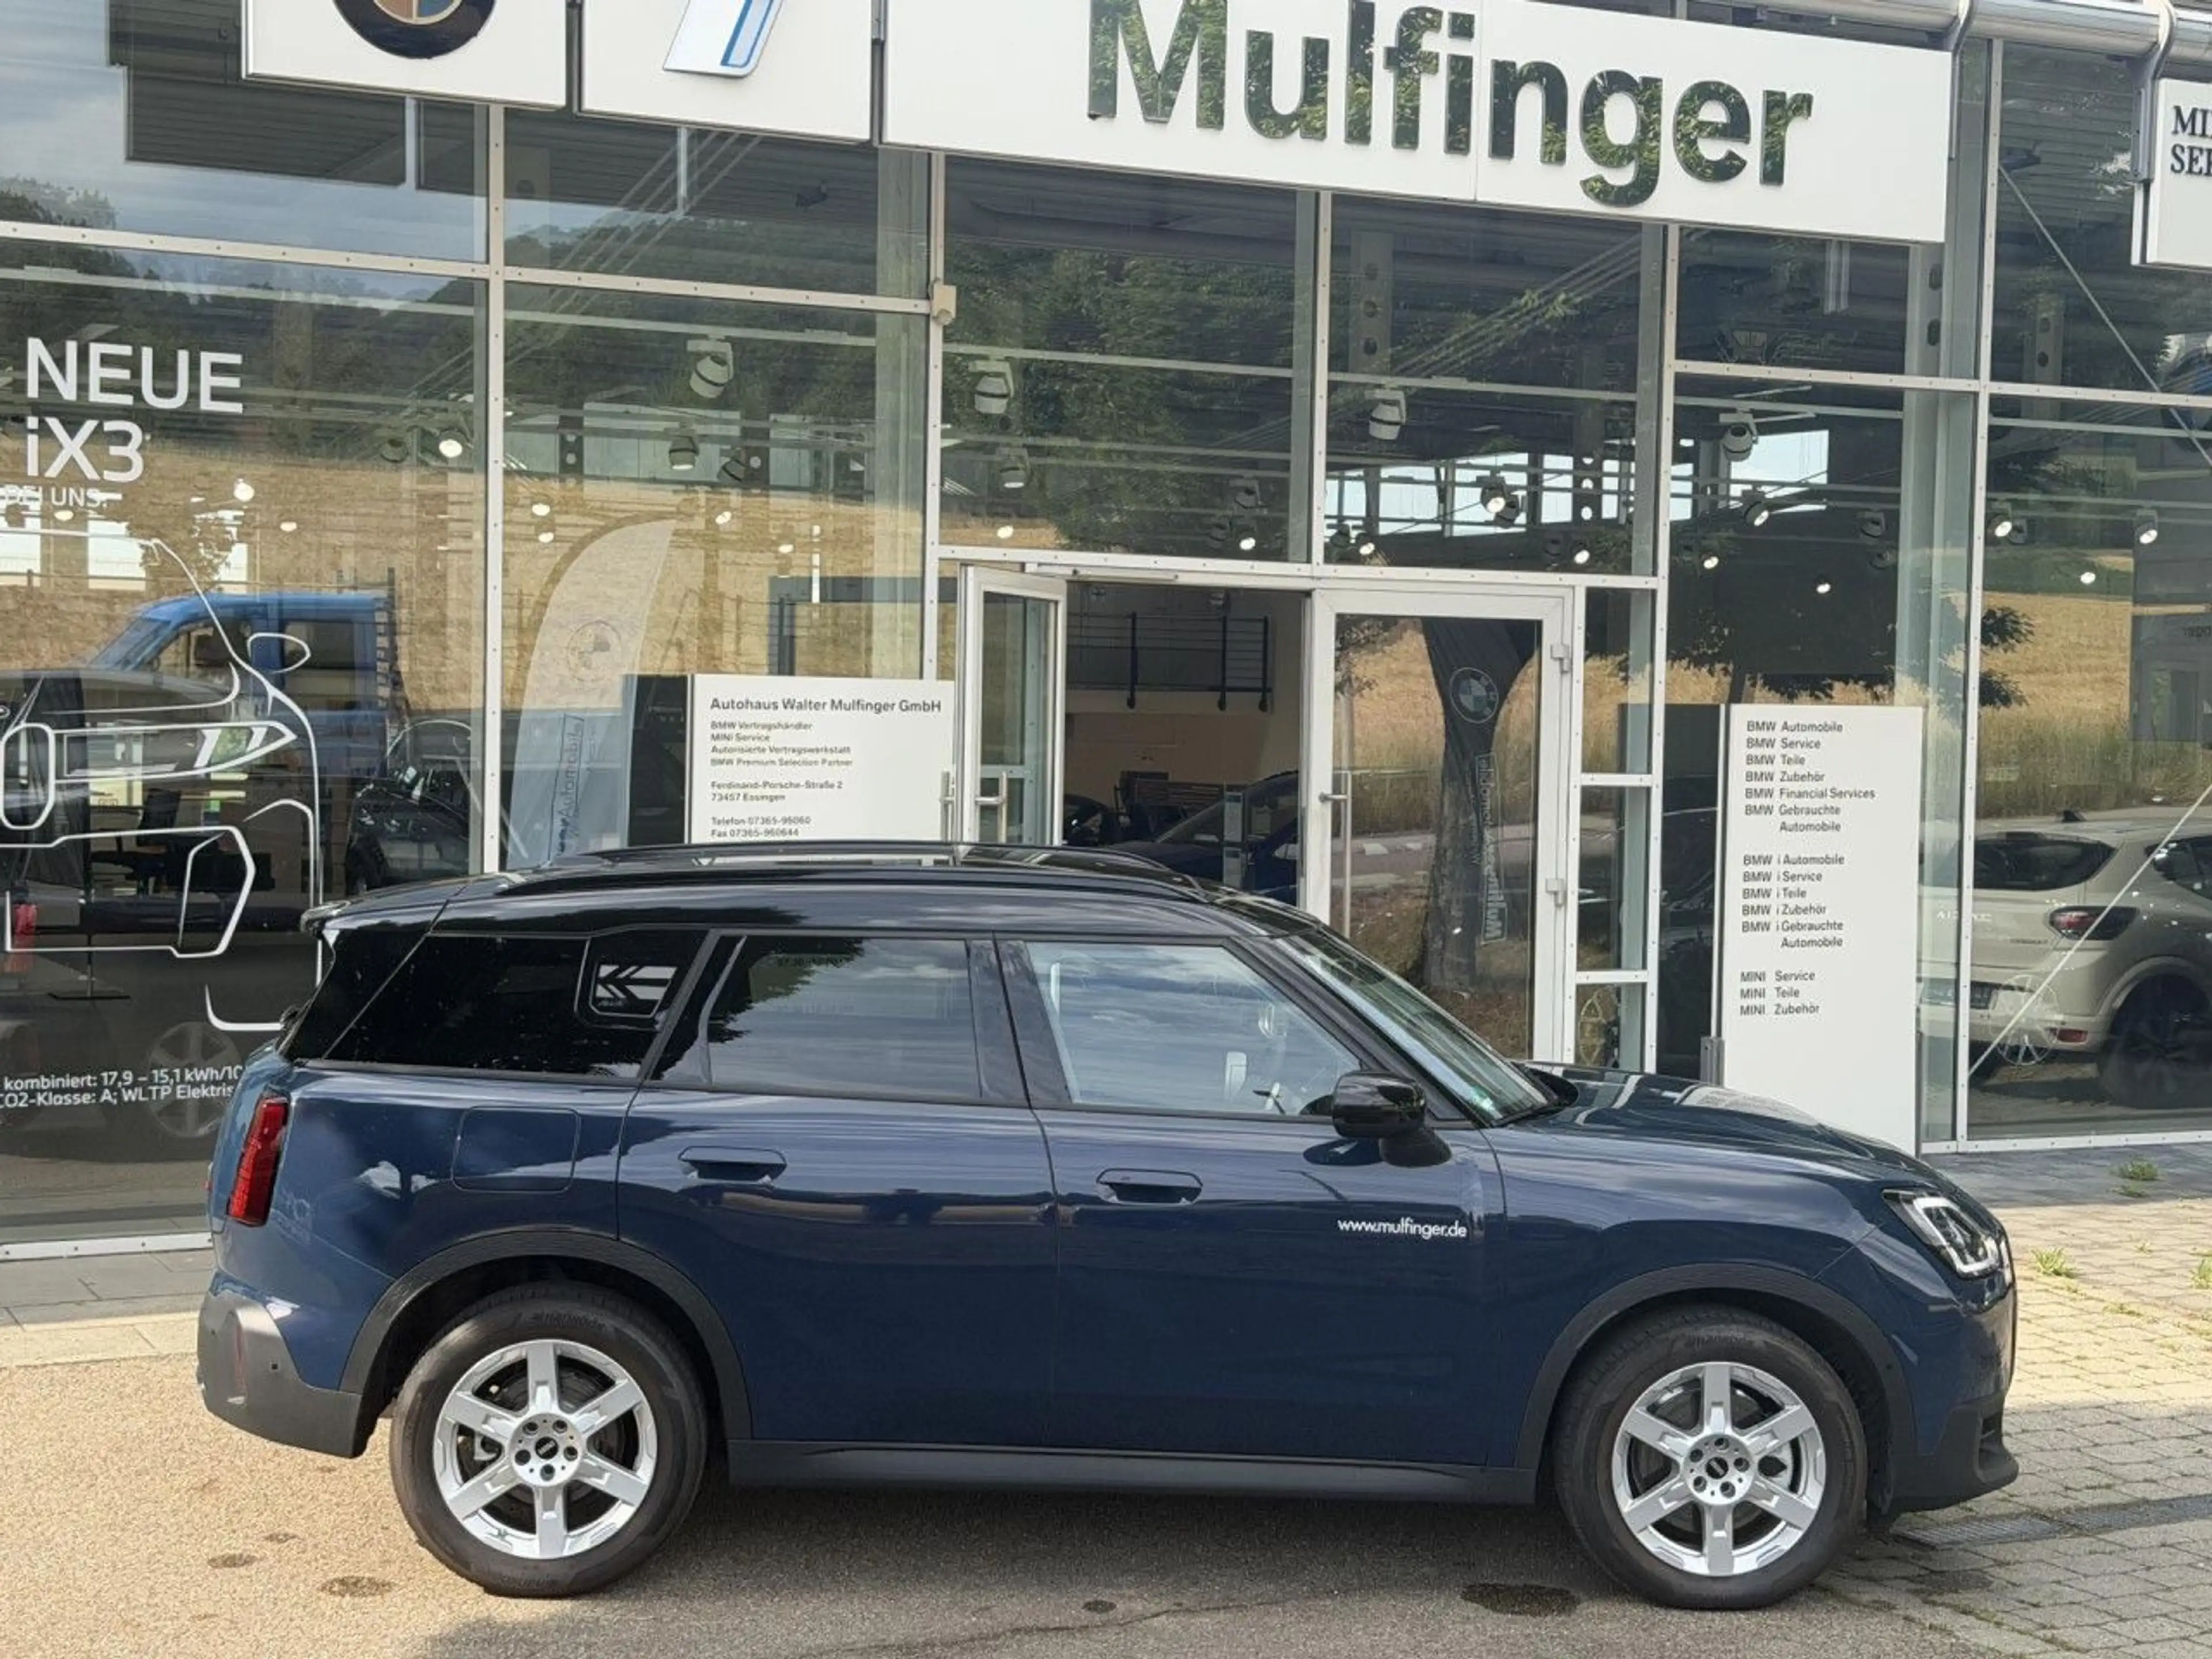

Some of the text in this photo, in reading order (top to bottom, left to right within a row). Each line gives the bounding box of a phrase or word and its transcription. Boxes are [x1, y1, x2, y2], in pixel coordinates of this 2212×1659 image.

[1089, 0, 1813, 207] Mulfinger
[2171, 105, 2212, 138] MI
[26, 337, 243, 414] NEUE
[26, 417, 144, 483] iX3
[710, 698, 941, 714] Autohaus Walter Mulfinger GmbH
[710, 721, 813, 732] BMW Vertragshändler
[1747, 720, 1843, 733] BMW Automobile
[710, 733, 770, 742] MINI Service
[1747, 737, 1821, 749] BMW Service
[769, 745, 851, 755] Vertragswerkstatt
[710, 757, 853, 767] BMW Premium Selection Partner
[1746, 753, 1805, 766] BMW Teile
[1745, 770, 1825, 782] BMW Zubehör
[836, 781, 843, 789] 2
[711, 793, 786, 803] 73457 Essingen
[1745, 787, 1876, 800] BMW Financial Services
[1744, 804, 1841, 816] BMW Gebrauchte
[711, 816, 745, 825] Telefon
[1779, 821, 1842, 832] Automobile
[711, 829, 727, 838] Fax
[1743, 854, 1773, 866] BMW
[1782, 854, 1845, 865] Automobile
[1743, 871, 1772, 882] BMW
[1782, 871, 1823, 882] Service
[1743, 888, 1772, 900] BMW
[1782, 887, 1807, 899] Teile
[1742, 904, 1771, 916] BMW
[1782, 903, 1827, 915] Zubehör
[1741, 921, 1771, 933] BMW
[1781, 920, 1844, 932] Gebrauchte
[1781, 937, 1843, 948] Automobile
[1740, 970, 1816, 983] MINI Service
[1740, 987, 1800, 999] MINI Teile
[1740, 1003, 1820, 1016] MINI Zubehör
[4, 1073, 97, 1091] kombiniert:
[100, 1071, 133, 1088] 17,9
[152, 1068, 181, 1084] 15,1
[121, 1085, 172, 1102] WLTP
[1338, 1217, 1468, 1240] www.mulfinger.de
